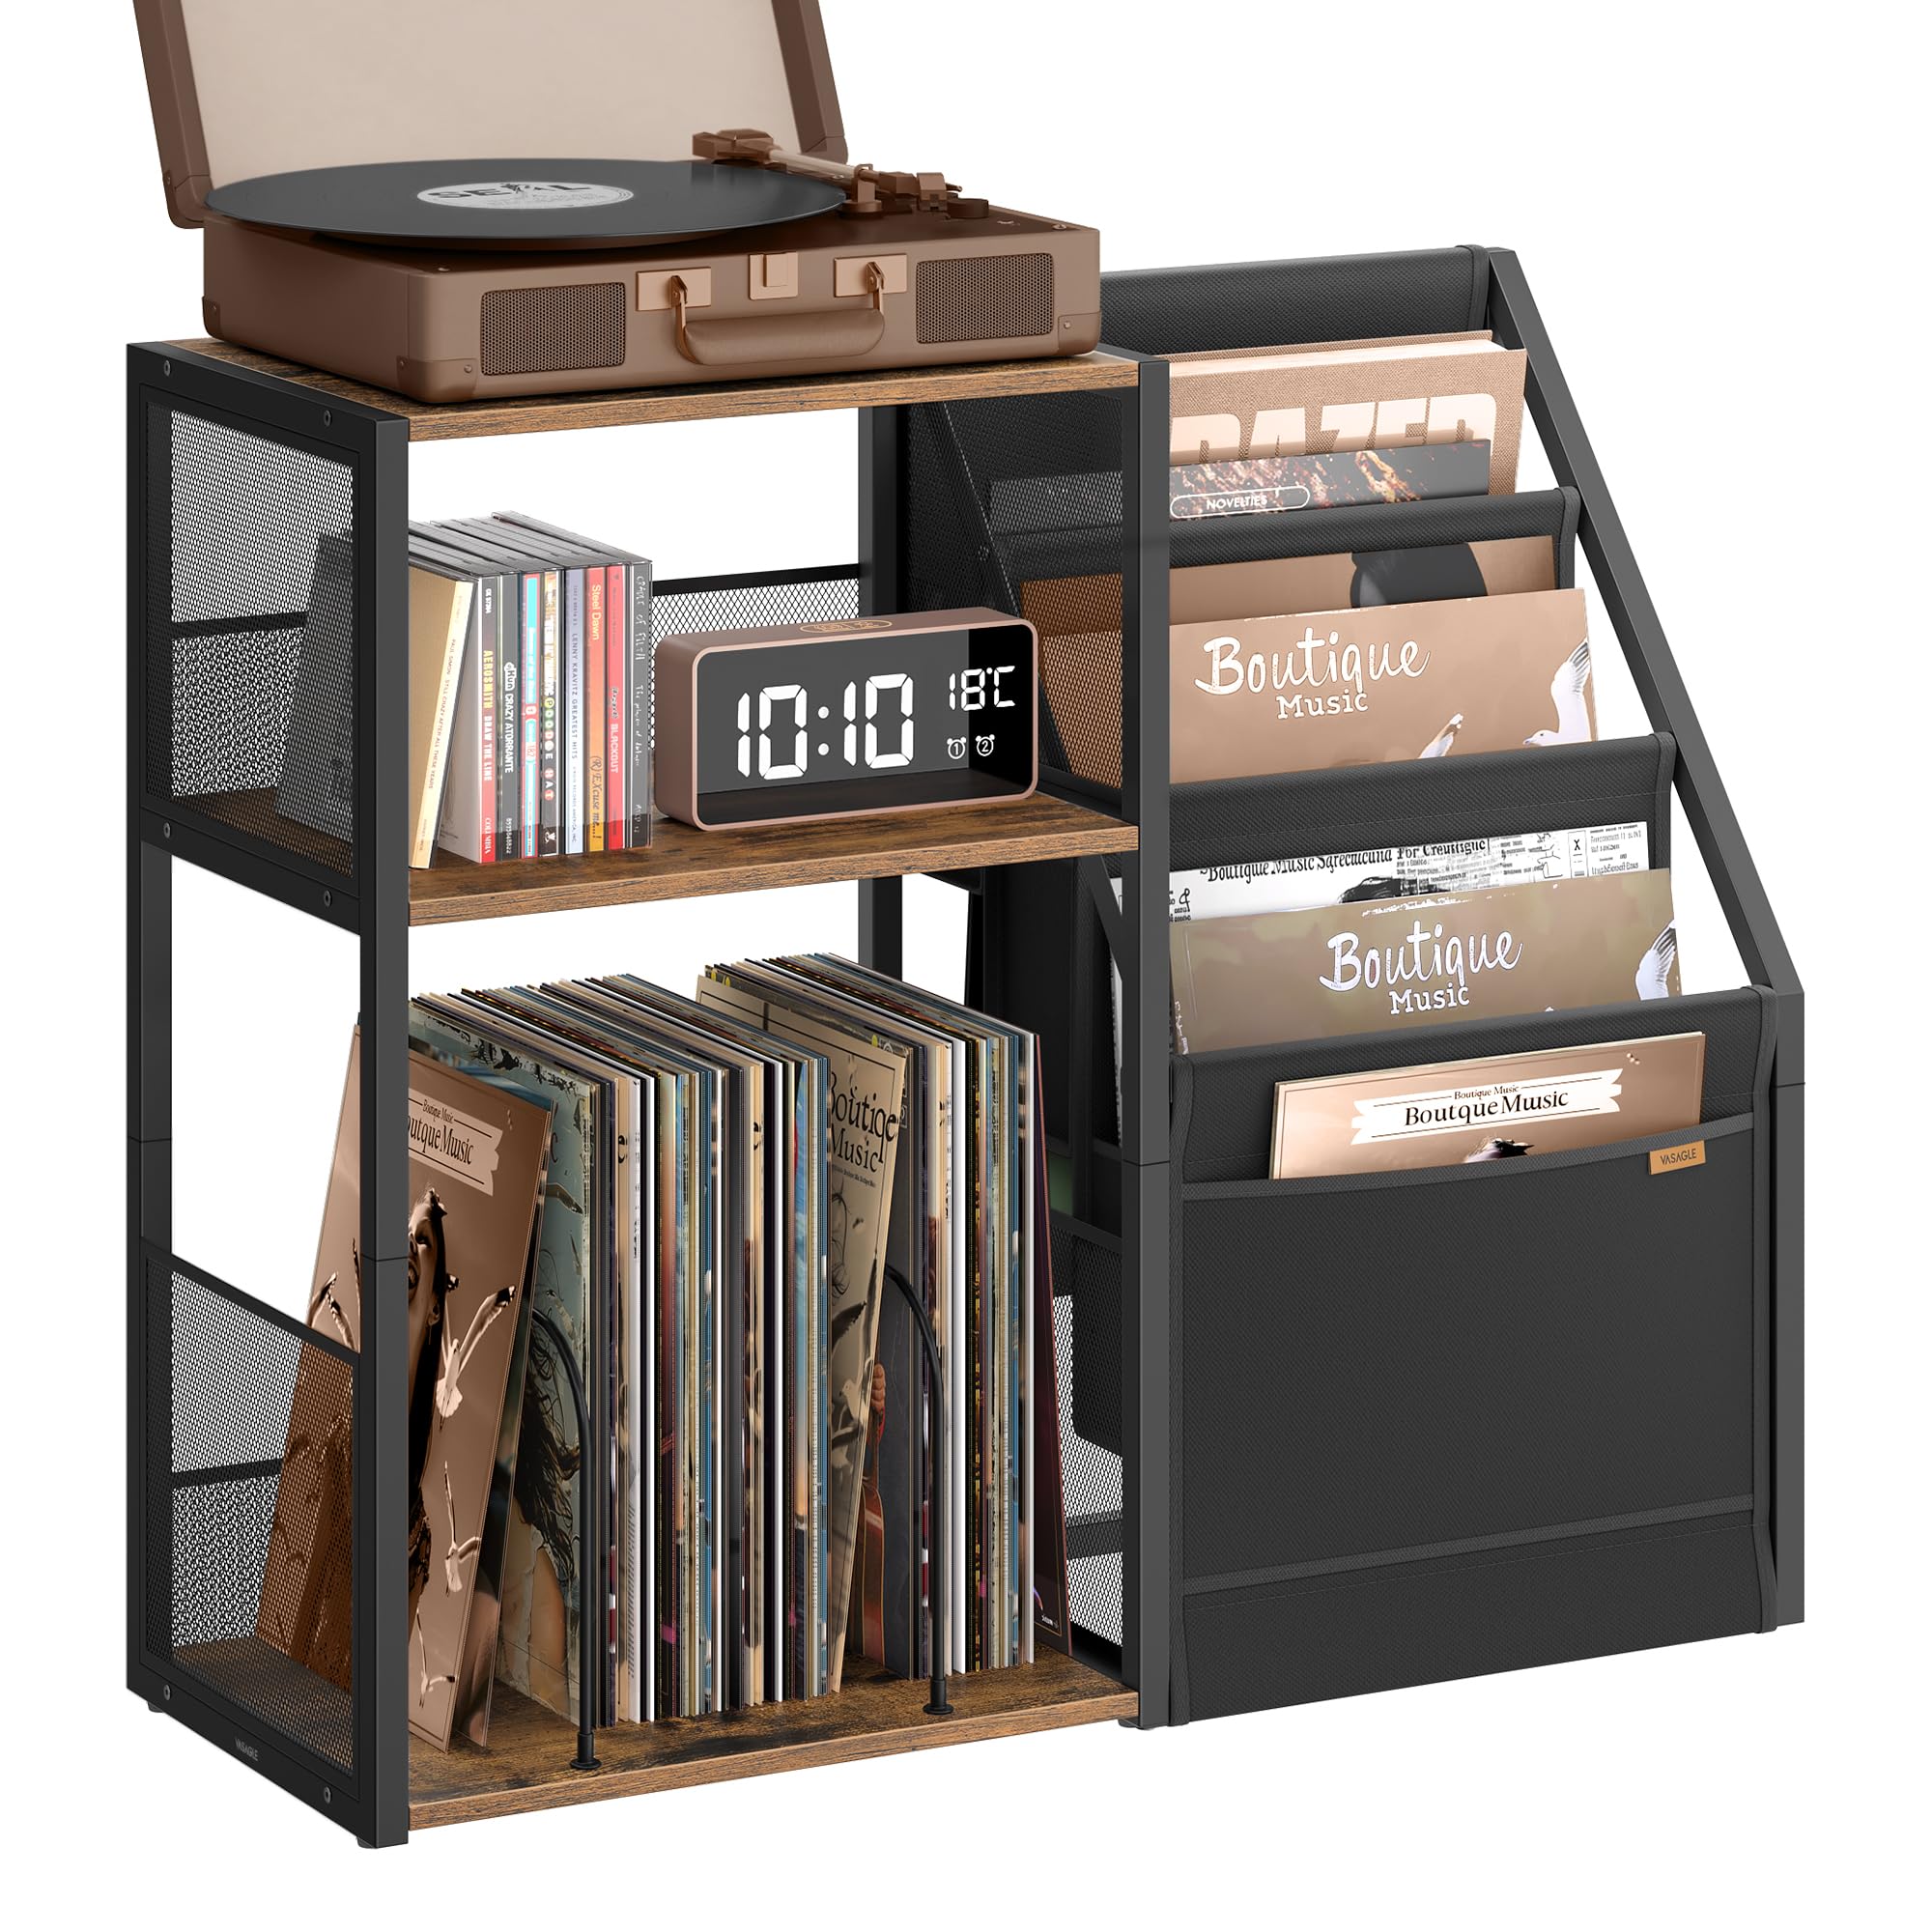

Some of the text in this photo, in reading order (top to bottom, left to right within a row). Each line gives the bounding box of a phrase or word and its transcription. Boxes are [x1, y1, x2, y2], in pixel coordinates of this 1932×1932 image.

[1206, 495, 1268, 510] NOVELTIES
[591, 584, 601, 639] Steel Dawn
[1194, 626, 1431, 696] Boutique
[483, 650, 494, 781] AEROSMITH DRAW THE LINE
[505, 694, 514, 721] CRAZY
[737, 672, 914, 781] 10:10
[1276, 690, 1369, 720] Music
[505, 723, 514, 773] ATORRANTE
[544, 697, 555, 801] POODE HAT
[1319, 920, 1523, 992] Boutique
[1389, 981, 1469, 1014] Music
[441, 1107, 454, 1124] Music
[1453, 1084, 1520, 1101] Boutique Music
[832, 1123, 878, 1173] Music
[1660, 1148, 1697, 1166] VASAGLE
